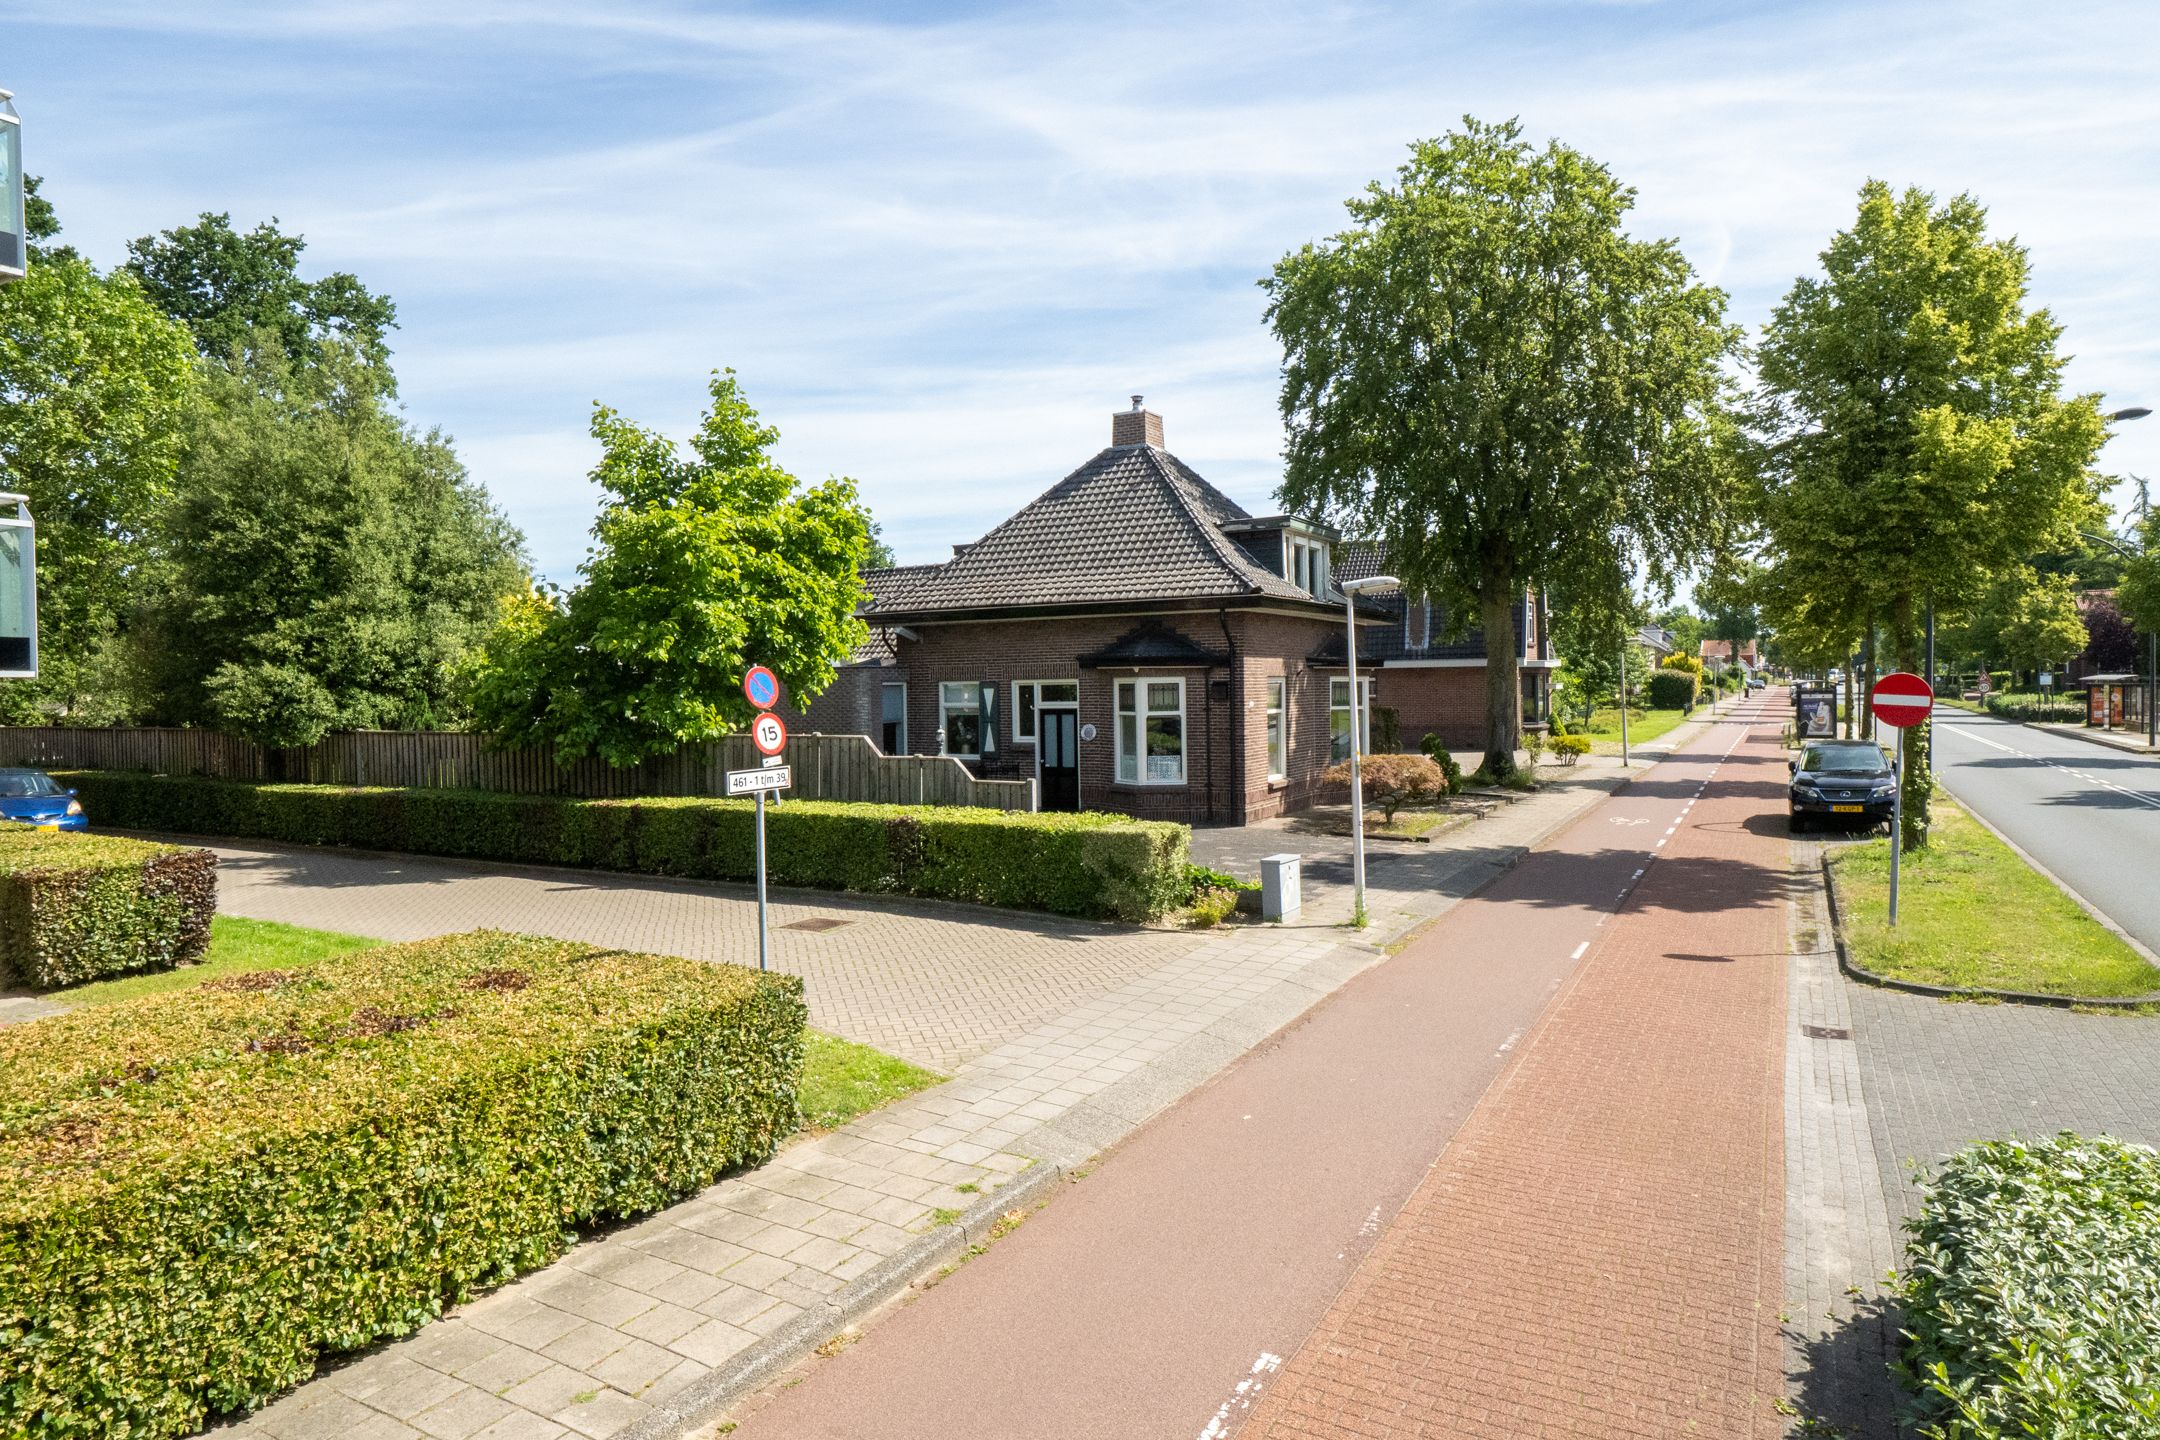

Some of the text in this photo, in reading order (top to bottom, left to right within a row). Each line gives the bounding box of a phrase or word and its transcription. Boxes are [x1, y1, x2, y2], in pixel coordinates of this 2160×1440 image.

[762, 726, 778, 742] 15
[733, 777, 747, 787] 461
[755, 775, 759, 785] 1
[761, 774, 774, 786] t/m
[776, 772, 786, 783] 39
